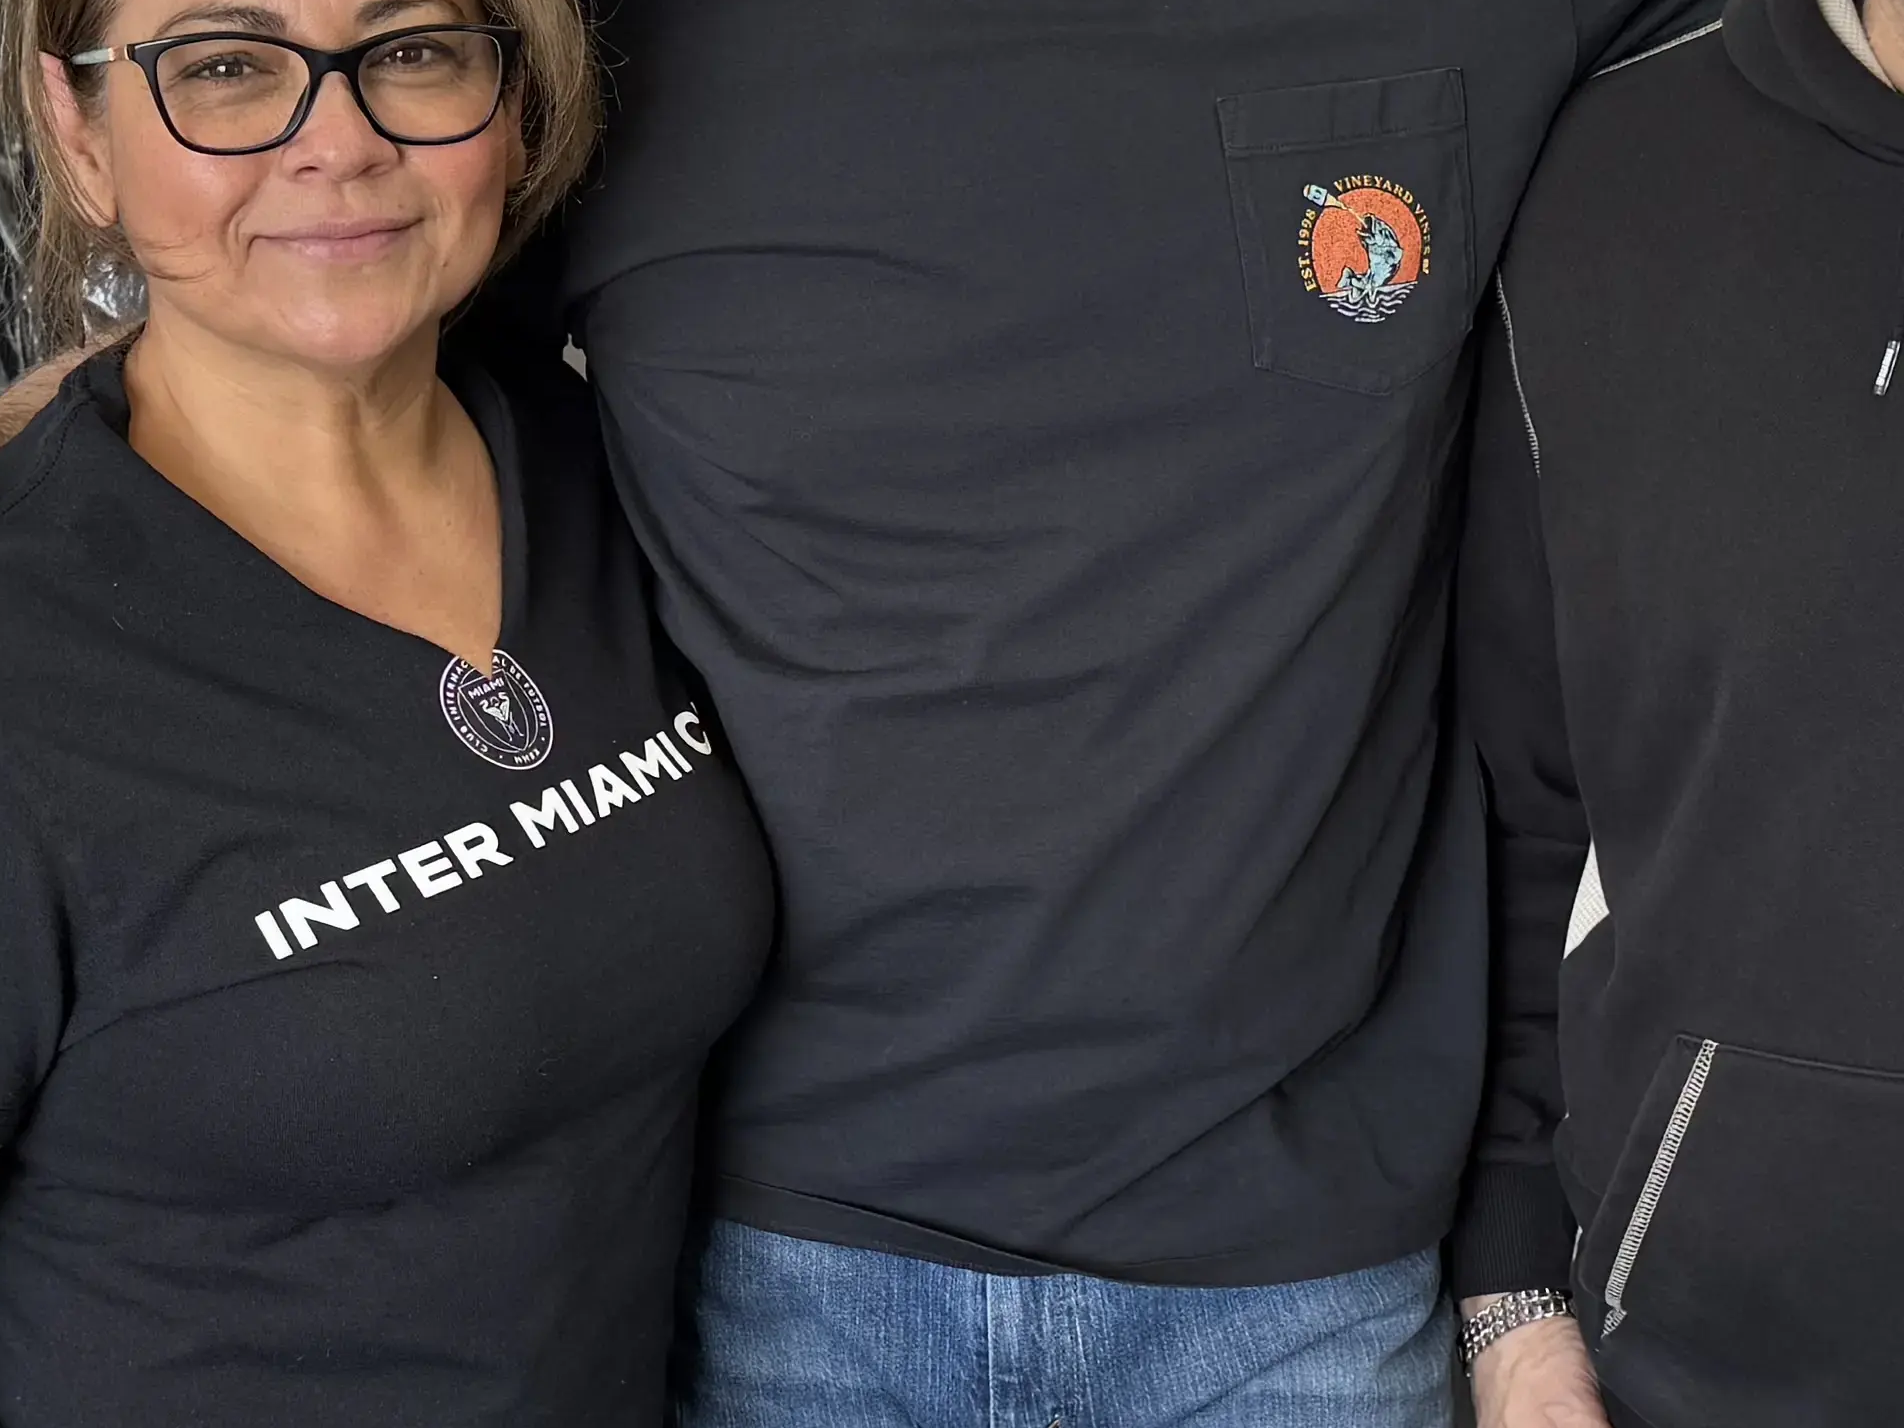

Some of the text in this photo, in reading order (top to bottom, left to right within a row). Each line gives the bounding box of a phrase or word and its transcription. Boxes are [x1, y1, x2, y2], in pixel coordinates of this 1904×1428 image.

[1298, 208, 1318, 292] EST. 1998
[1333, 174, 1432, 256] VINEYARD VINES
[468, 677, 505, 700] MIAMI
[459, 725, 488, 754] CLUB
[255, 702, 712, 960] INTER MIAMI C
